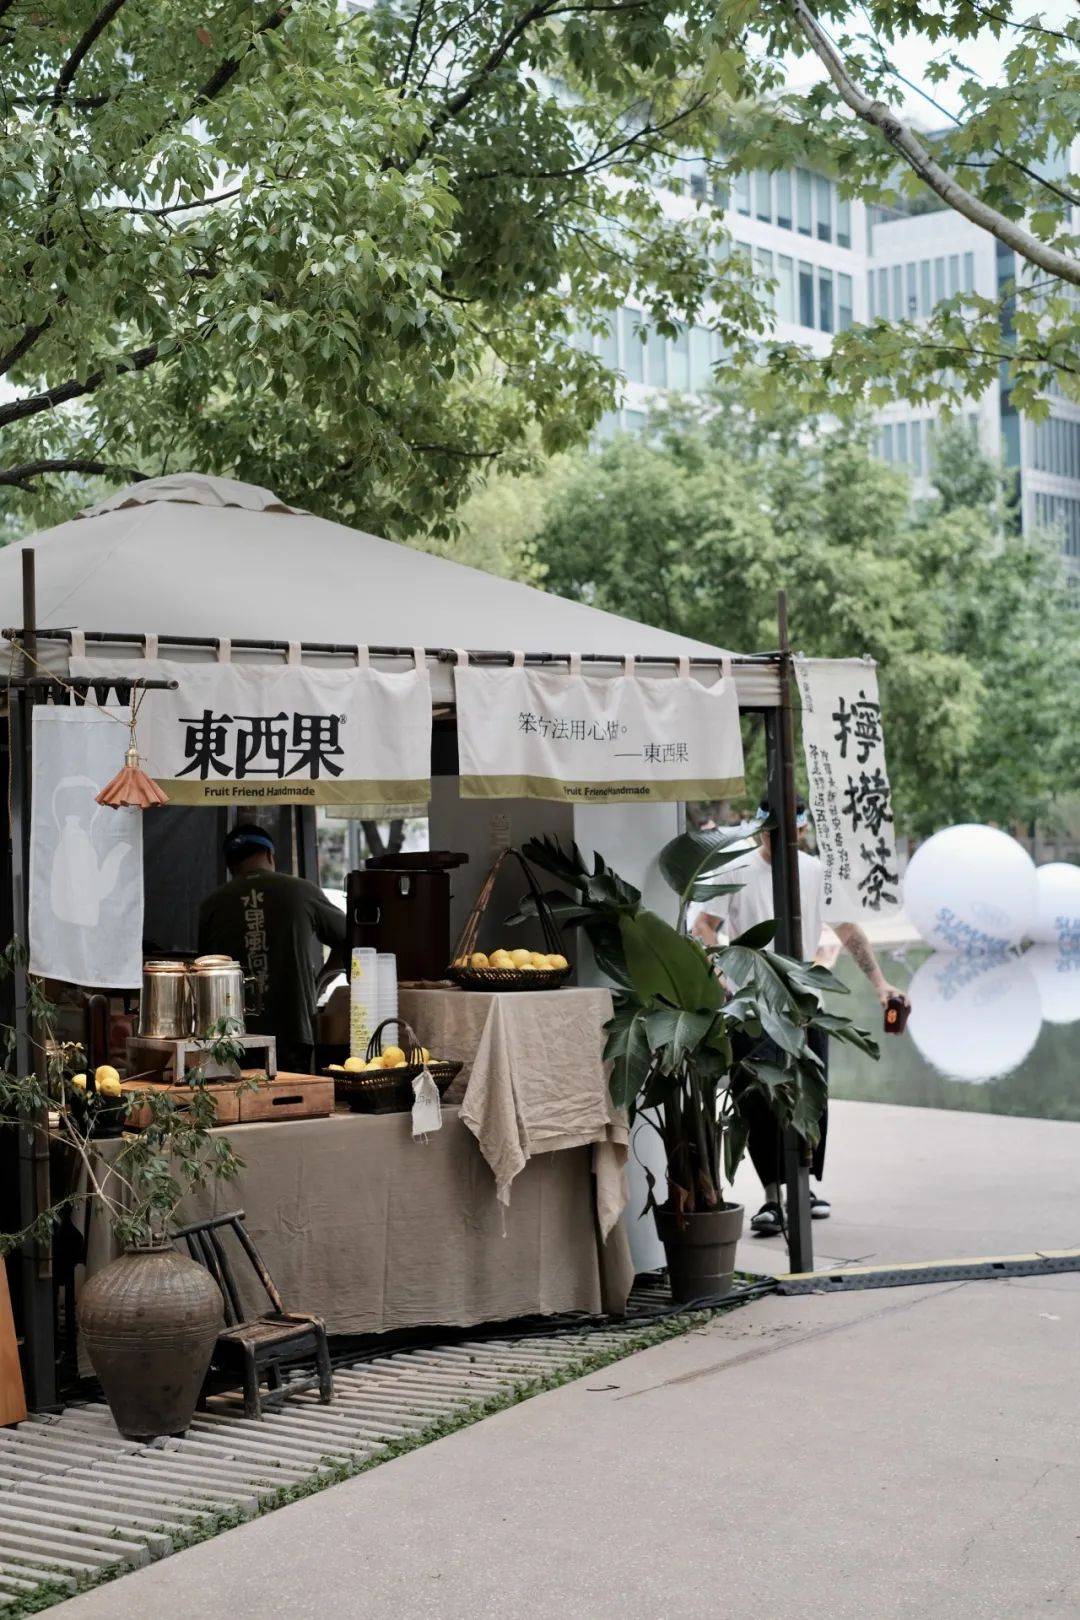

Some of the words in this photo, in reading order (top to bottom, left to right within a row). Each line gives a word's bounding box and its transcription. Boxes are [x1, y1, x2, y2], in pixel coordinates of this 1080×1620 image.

[175, 709, 344, 780] 東西果
[204, 787, 230, 796] Fruit
[232, 786, 265, 797] Friend
[266, 786, 316, 797] Handmade
